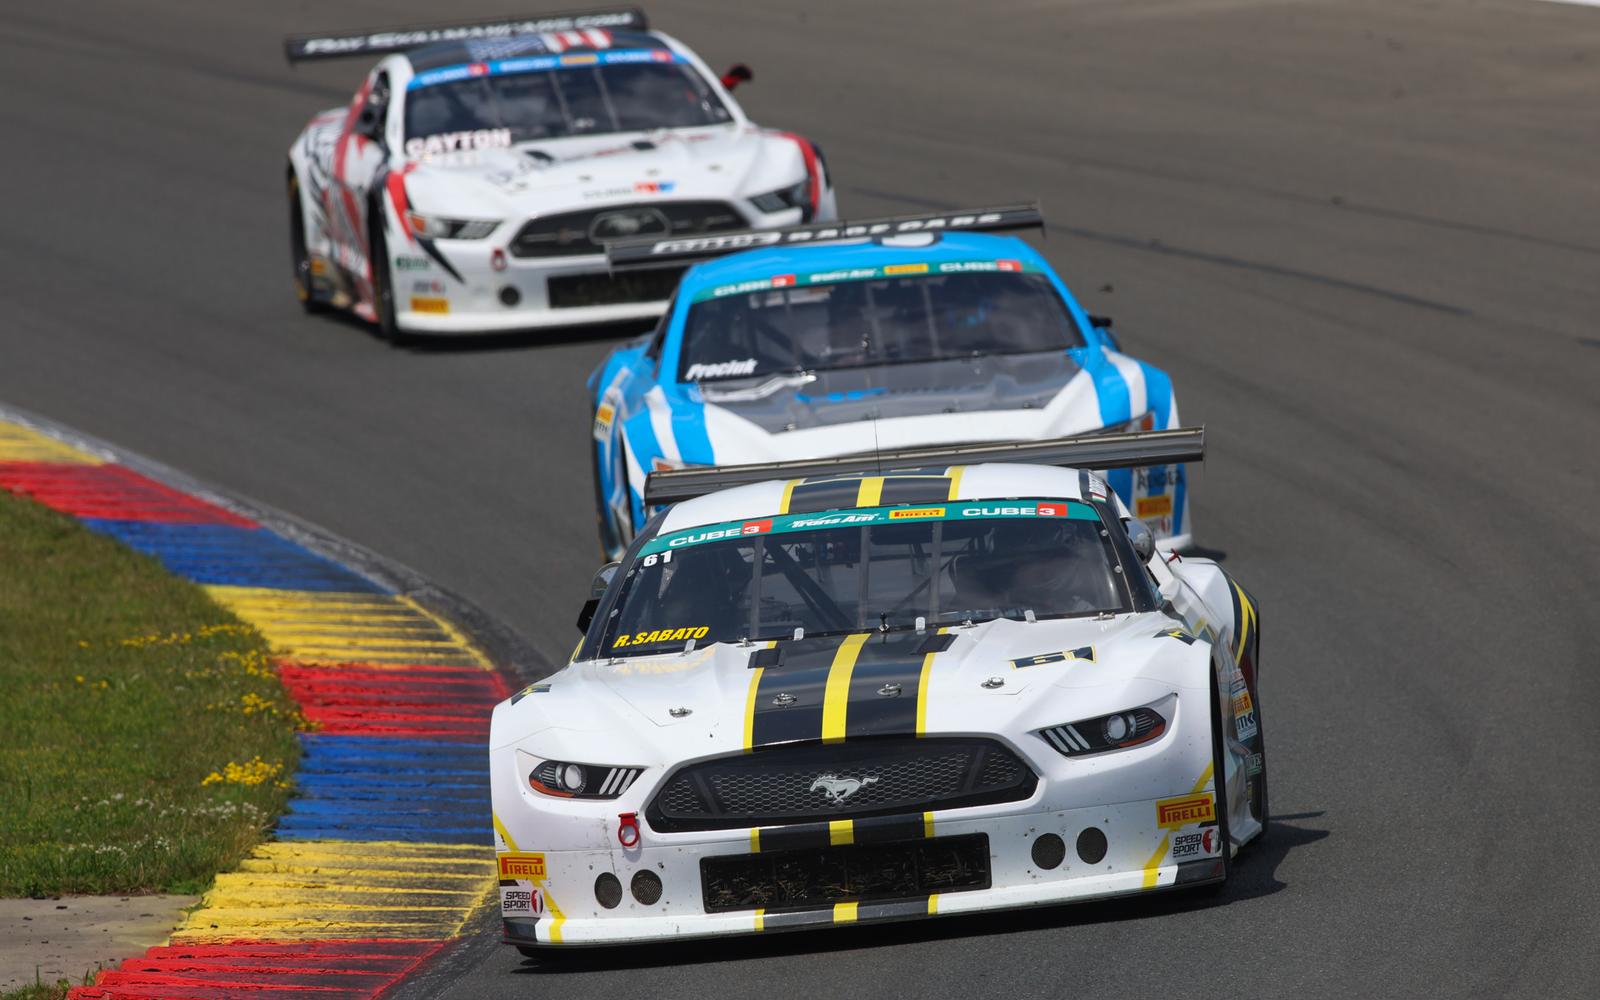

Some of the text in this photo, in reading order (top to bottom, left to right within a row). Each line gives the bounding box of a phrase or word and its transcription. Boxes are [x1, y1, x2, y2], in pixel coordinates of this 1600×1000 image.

[791, 511, 880, 528] Trans Am
[962, 506, 1057, 517] CUBE3
[668, 525, 760, 547] CUBE3
[643, 550, 673, 567] 61
[612, 626, 710, 649] R.SABATO
[1159, 798, 1211, 824] PIRELLI
[1174, 833, 1203, 846] SPEED
[1172, 842, 1202, 855] SPORT
[500, 857, 544, 876] PIRELLI
[505, 891, 531, 900] SPEED
[503, 900, 531, 909] SPORT
